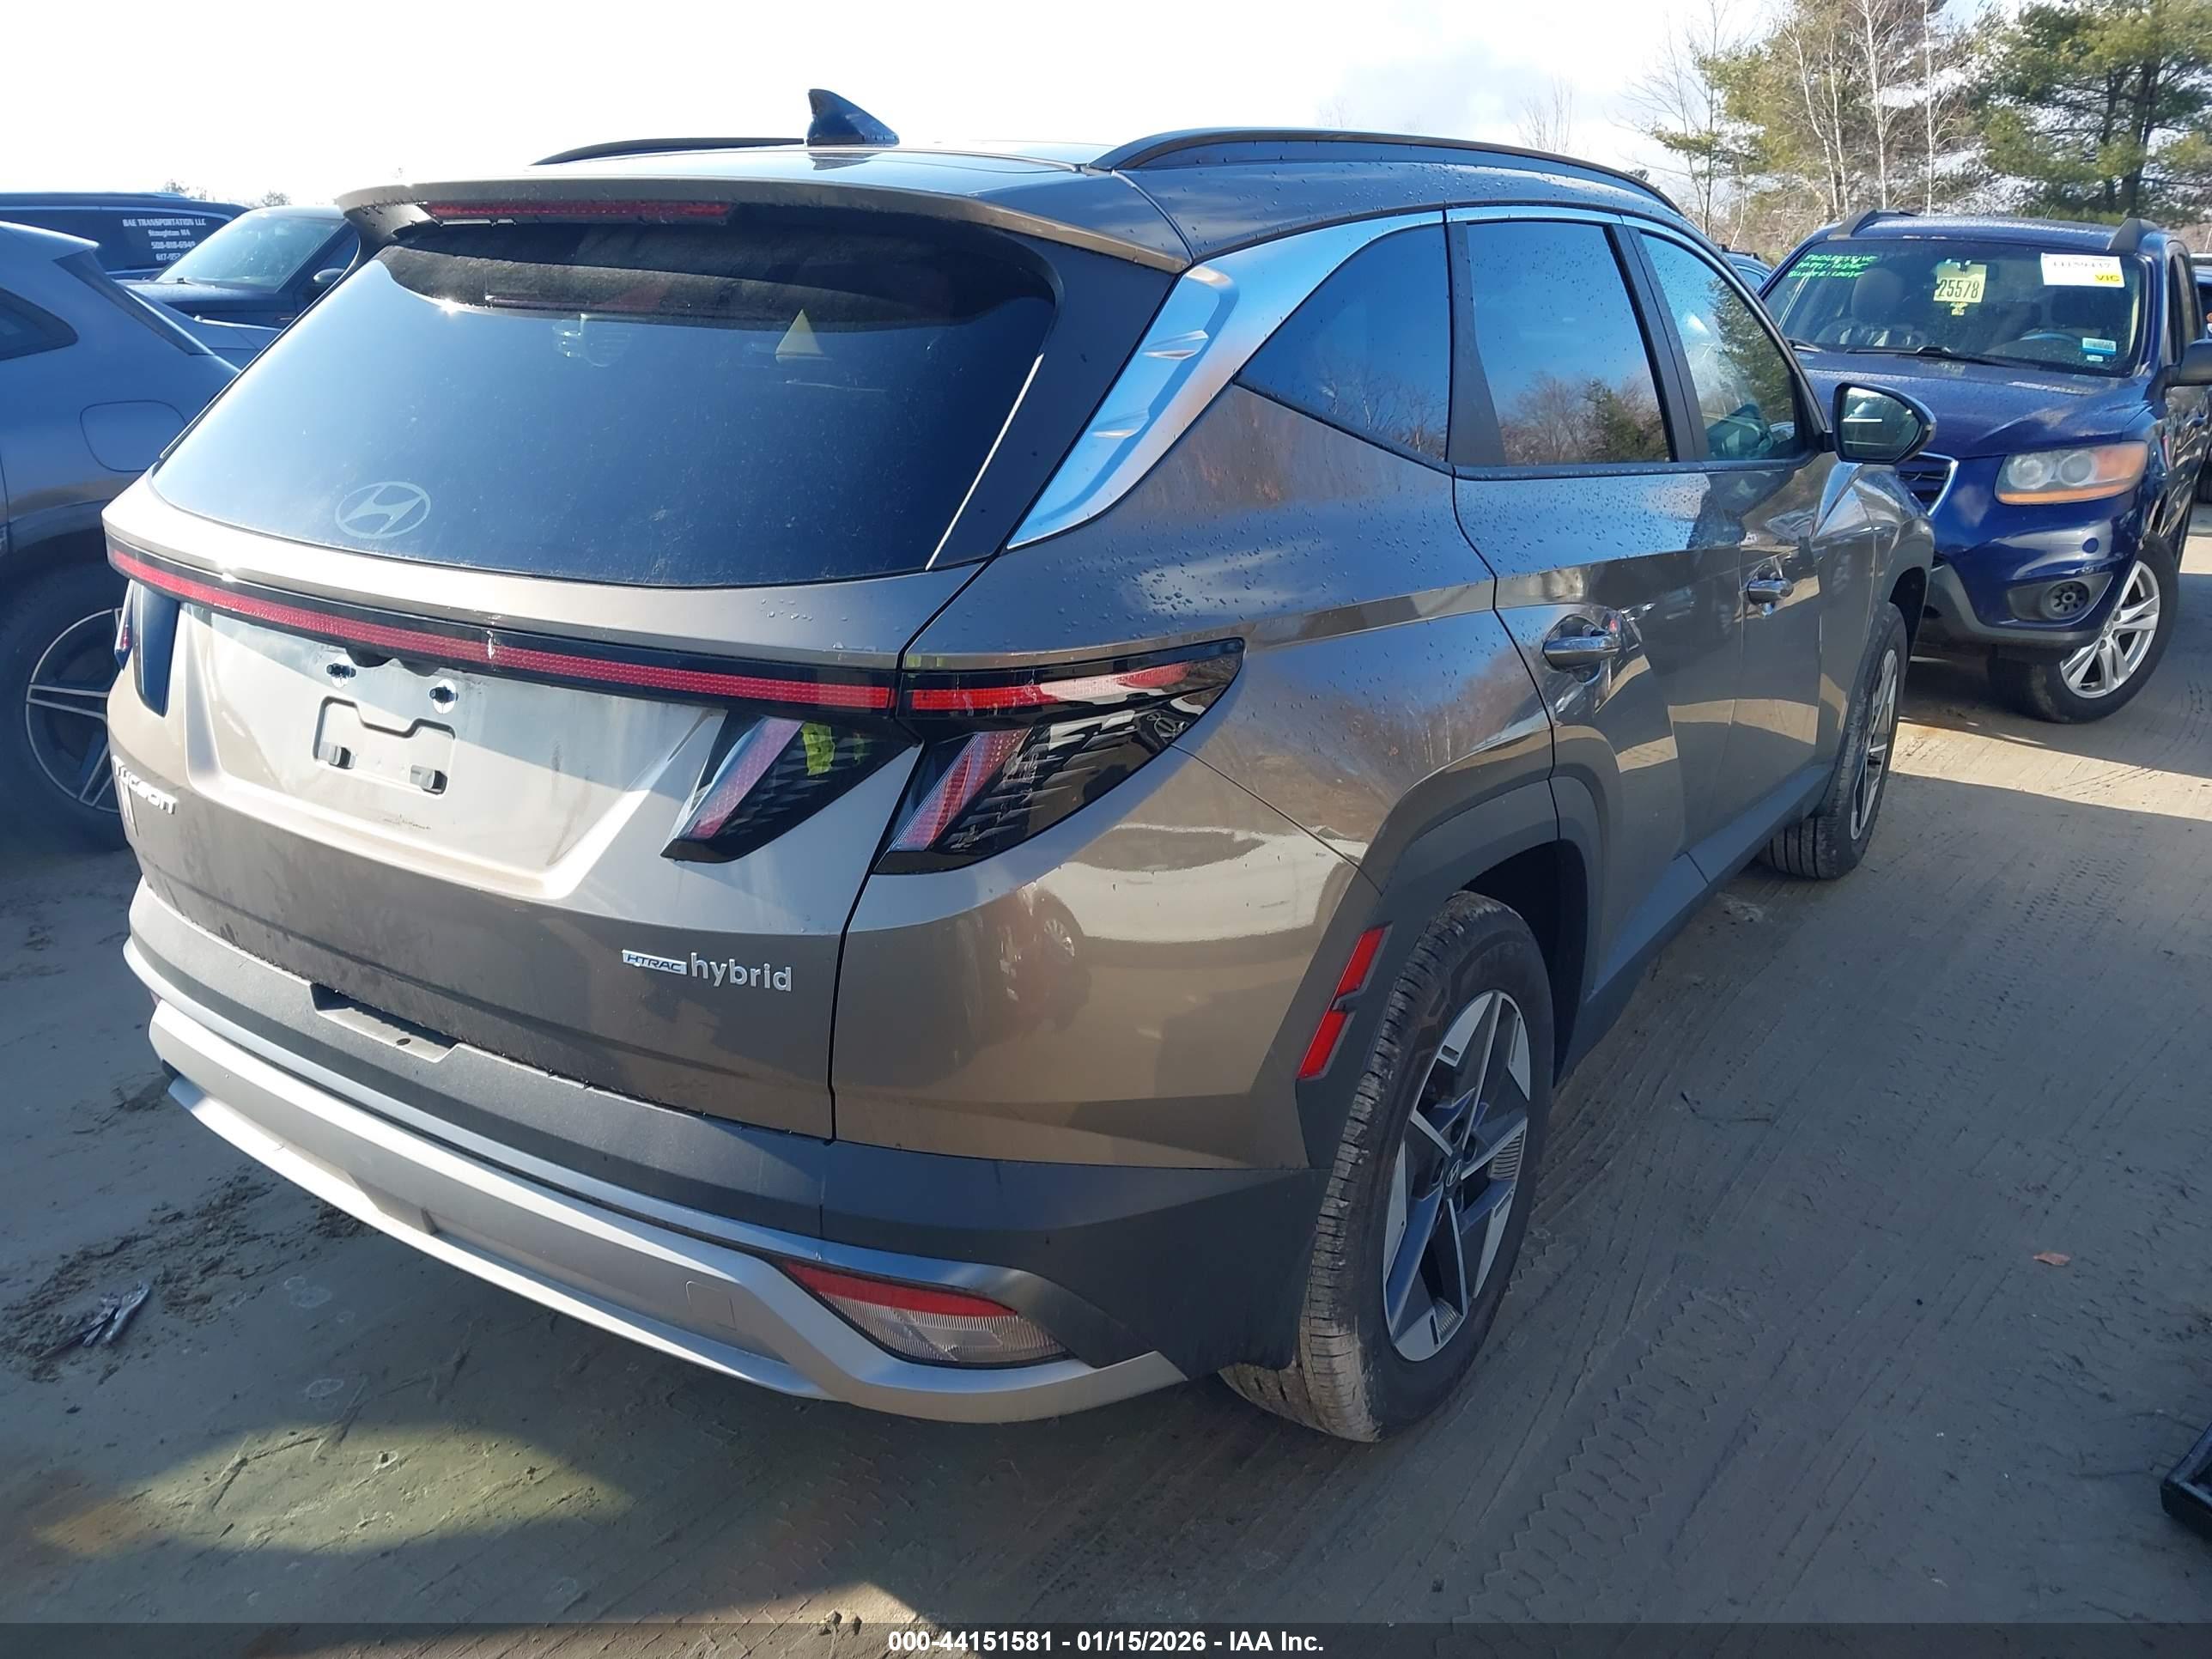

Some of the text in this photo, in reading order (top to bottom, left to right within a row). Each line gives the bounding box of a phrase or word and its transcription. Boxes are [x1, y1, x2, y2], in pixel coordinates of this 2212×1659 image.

[1938, 279, 1980, 299] 25578
[112, 755, 178, 815] TUCSON
[627, 951, 792, 992] HTRAC hybrid
